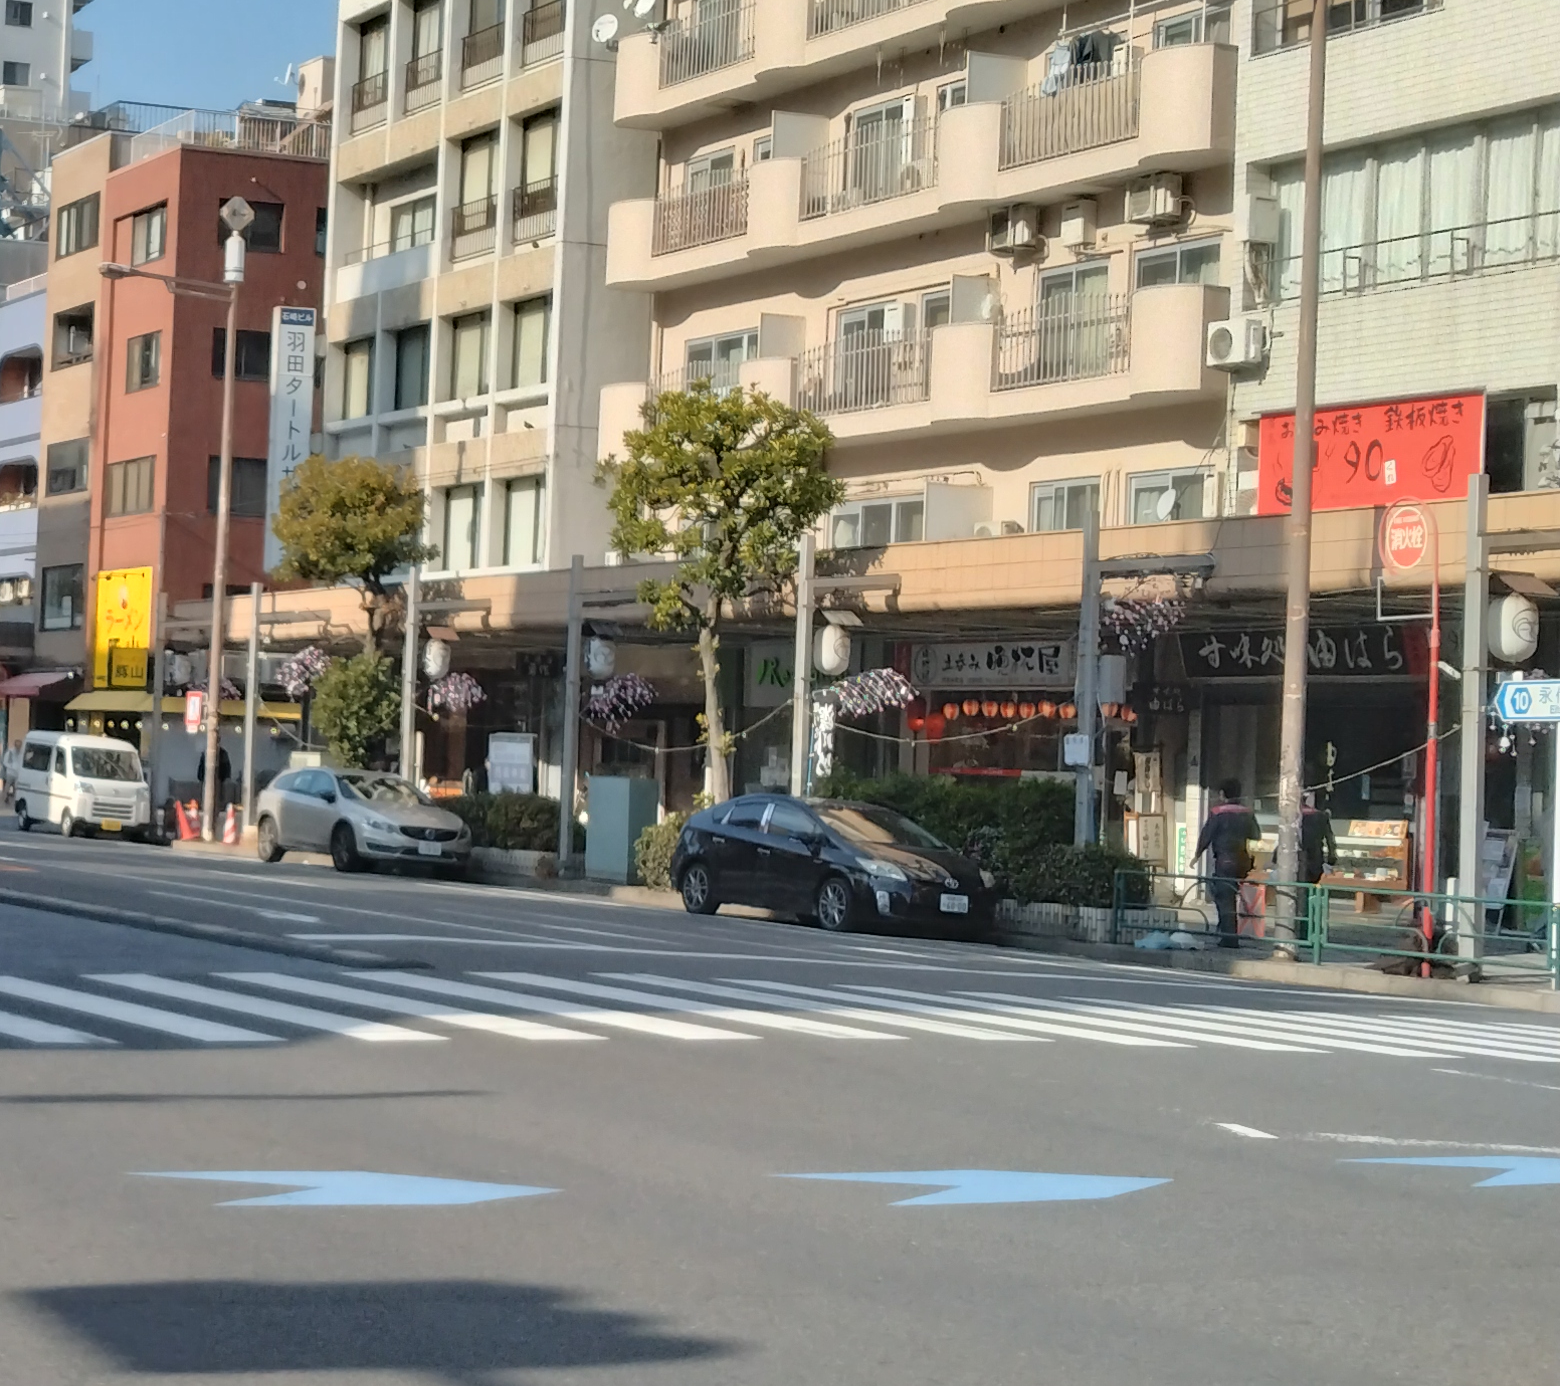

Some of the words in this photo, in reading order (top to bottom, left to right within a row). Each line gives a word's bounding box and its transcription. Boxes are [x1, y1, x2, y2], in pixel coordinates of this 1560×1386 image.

[1281, 412, 1362, 439] おみ焼き
[1383, 399, 1464, 433] 鉄板焼き
[1343, 439, 1384, 484] 90
[1391, 525, 1423, 551] 消火栓
[1513, 691, 1530, 711] 10
[1538, 687, 1560, 705] 永
